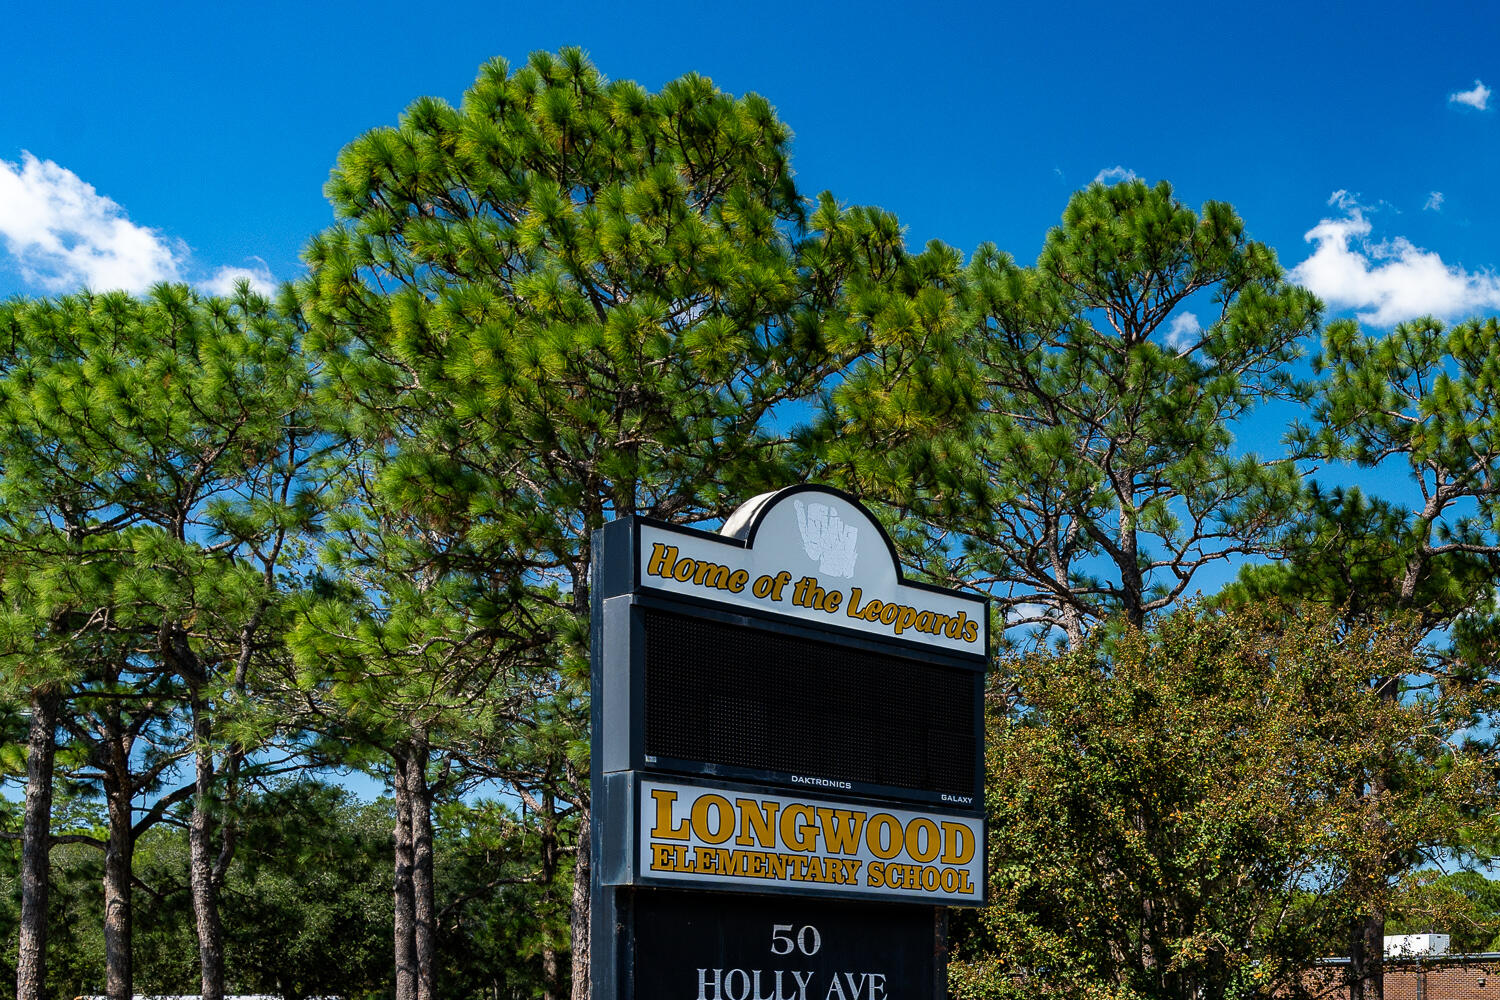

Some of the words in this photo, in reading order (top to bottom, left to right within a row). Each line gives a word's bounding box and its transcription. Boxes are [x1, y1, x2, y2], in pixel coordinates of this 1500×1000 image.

[648, 543, 748, 594] Home
[752, 571, 791, 601] of
[792, 577, 842, 614] the
[847, 588, 979, 643] Leopards
[791, 775, 852, 789] DAKTRONICS
[941, 794, 973, 804] GALAXY
[651, 789, 976, 865] LONGWOOD
[650, 843, 863, 885] ELEMENTARY
[867, 862, 975, 894] SCHOOL
[770, 924, 821, 956] 50
